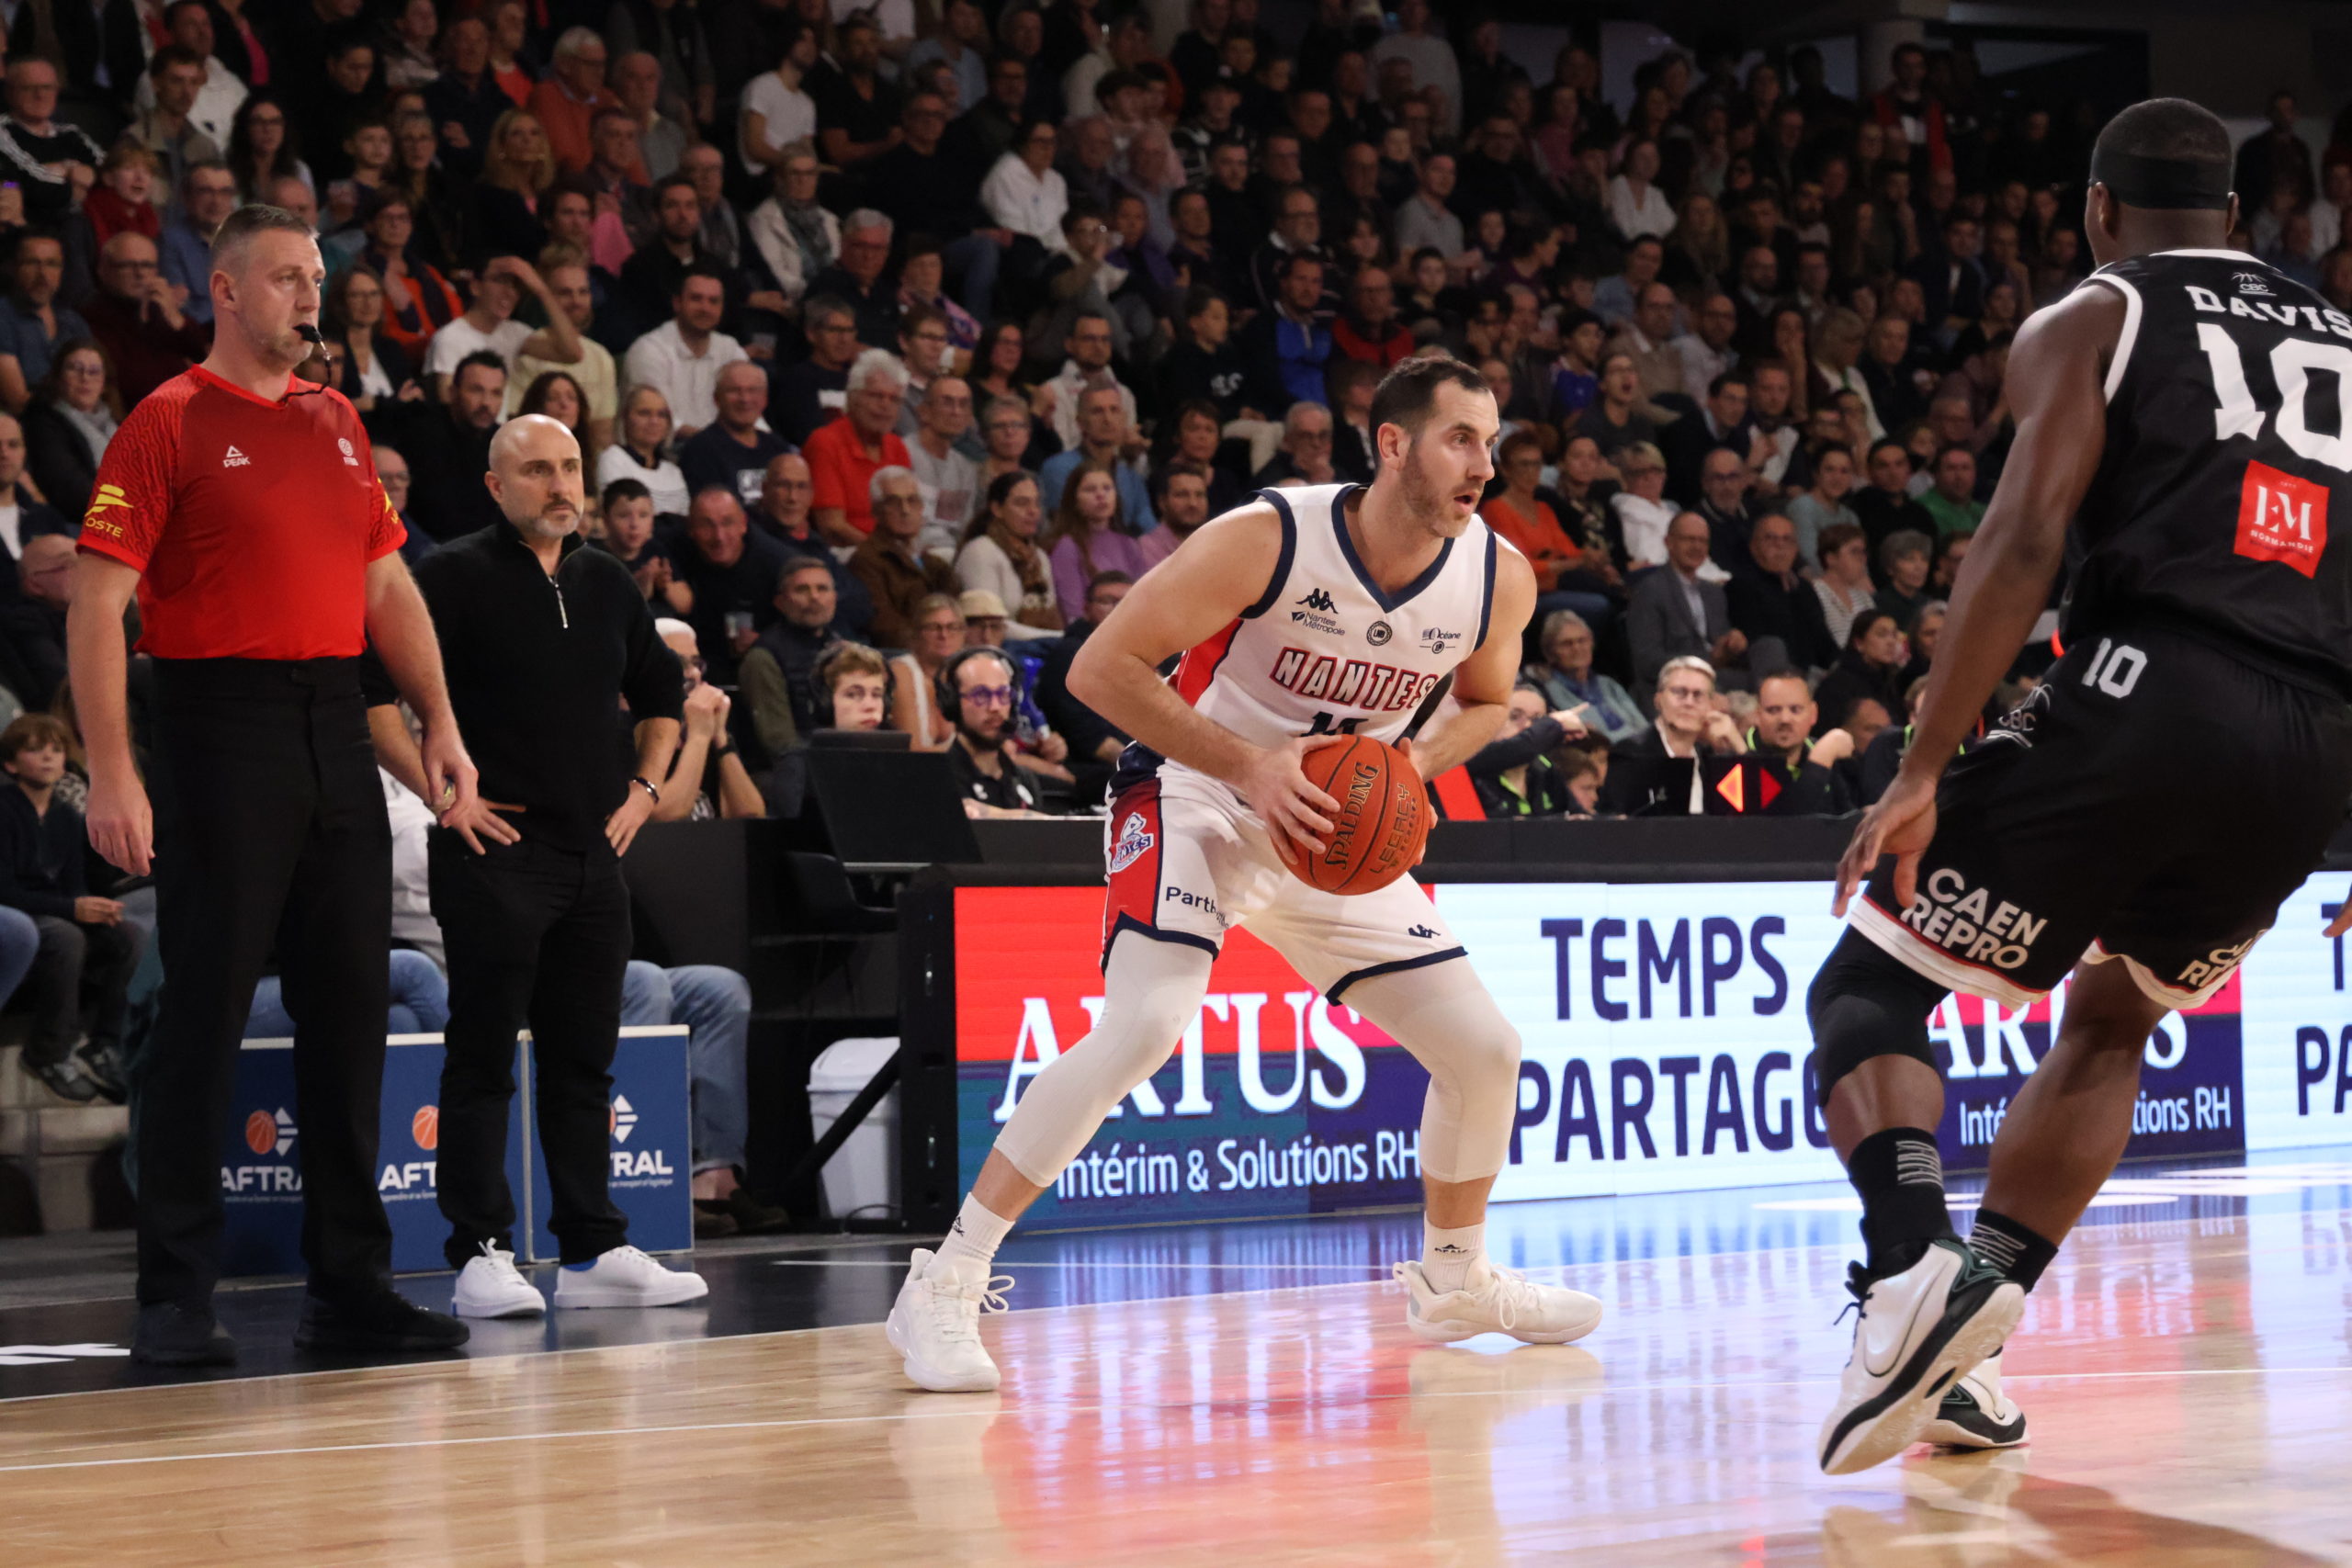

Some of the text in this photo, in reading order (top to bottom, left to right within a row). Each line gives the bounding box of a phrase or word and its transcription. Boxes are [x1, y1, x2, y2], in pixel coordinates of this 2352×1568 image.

[2184, 285, 2352, 341] DAVIS
[2196, 321, 2352, 473] 10
[222, 457, 251, 468] PEAK
[1302, 619, 1346, 637] Métropole
[1305, 611, 1337, 627] Nantes
[1269, 646, 1440, 712] NANTES
[2081, 637, 2148, 699] 10
[1324, 761, 1381, 871] SPALDING
[1900, 892, 2029, 969] REPRO
[1928, 868, 2048, 946] CAEN
[1541, 915, 1789, 1021] TEMPS
[1927, 974, 2188, 1078] ARS
[2194, 1086, 2232, 1131] RH
[1186, 1149, 1210, 1192] &
[1216, 1134, 1369, 1191] Solutions
[1375, 1129, 1421, 1181] RH
